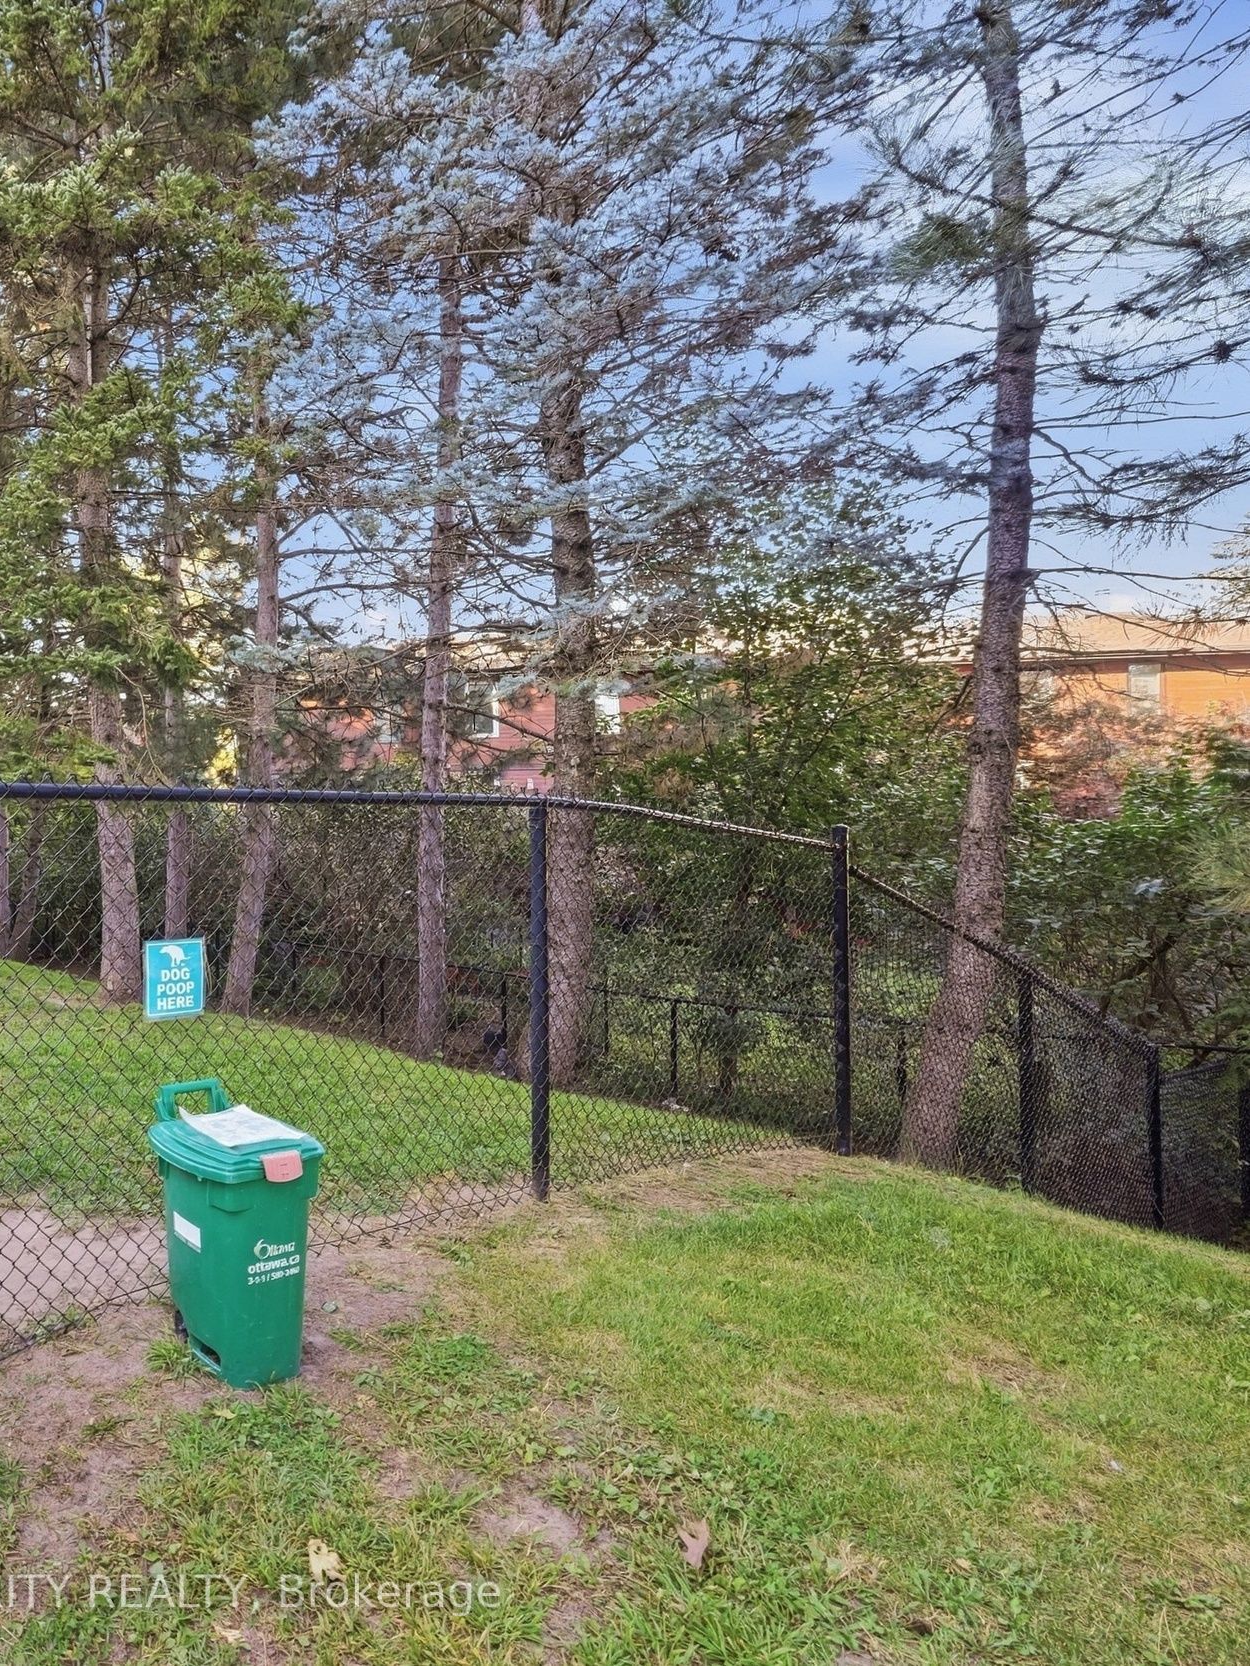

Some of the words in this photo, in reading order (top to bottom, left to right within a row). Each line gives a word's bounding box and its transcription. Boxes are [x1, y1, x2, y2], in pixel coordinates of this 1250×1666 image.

[160, 967, 191, 982] DOG
[156, 981, 195, 997] POOP
[156, 995, 195, 1011] HERE
[247, 1254, 300, 1275] ottawa.ca
